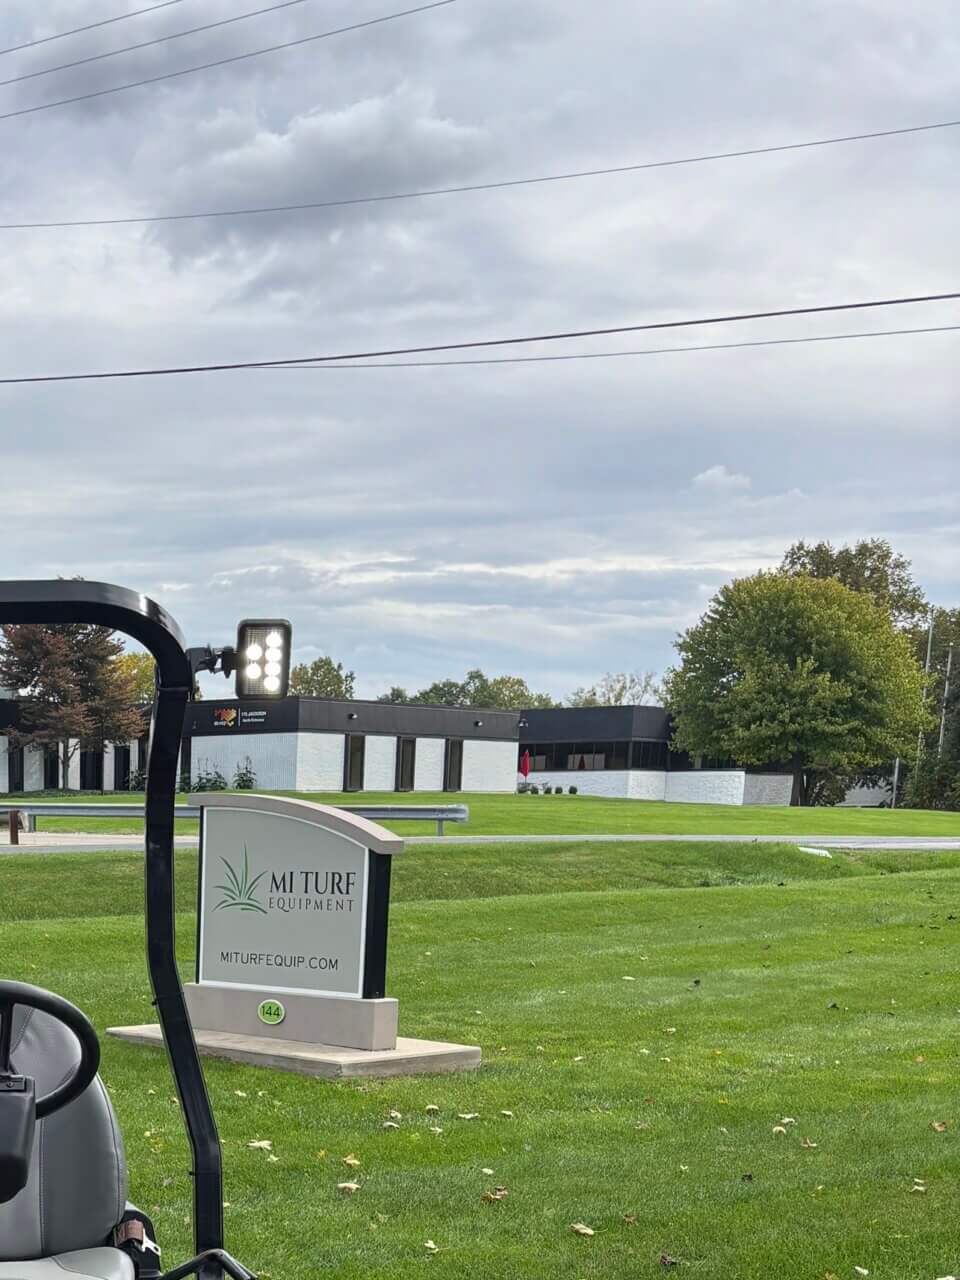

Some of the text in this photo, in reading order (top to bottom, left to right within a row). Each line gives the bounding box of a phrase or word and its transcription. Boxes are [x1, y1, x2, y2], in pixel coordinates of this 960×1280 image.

[269, 871, 357, 896] MI TURF
[268, 896, 356, 913] EQUIPMENT
[220, 951, 339, 971] MITURFEQUIP.COM
[261, 1005, 281, 1018] 144
